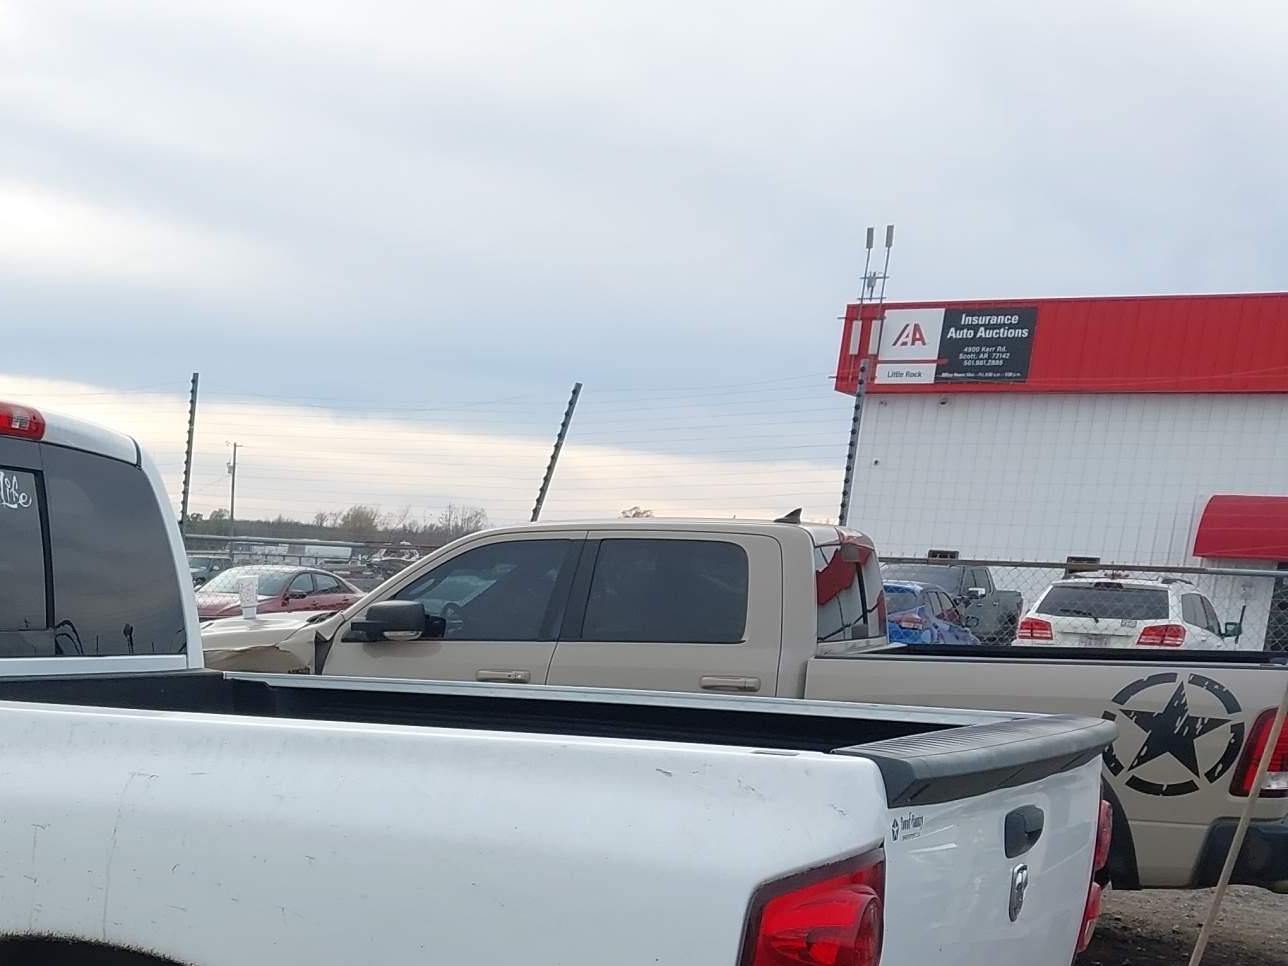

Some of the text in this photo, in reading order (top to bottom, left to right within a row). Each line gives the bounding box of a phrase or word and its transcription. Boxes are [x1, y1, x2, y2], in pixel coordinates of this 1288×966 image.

[961, 313, 1019, 325] Insurance
[947, 326, 1029, 339] Auto Auctions
